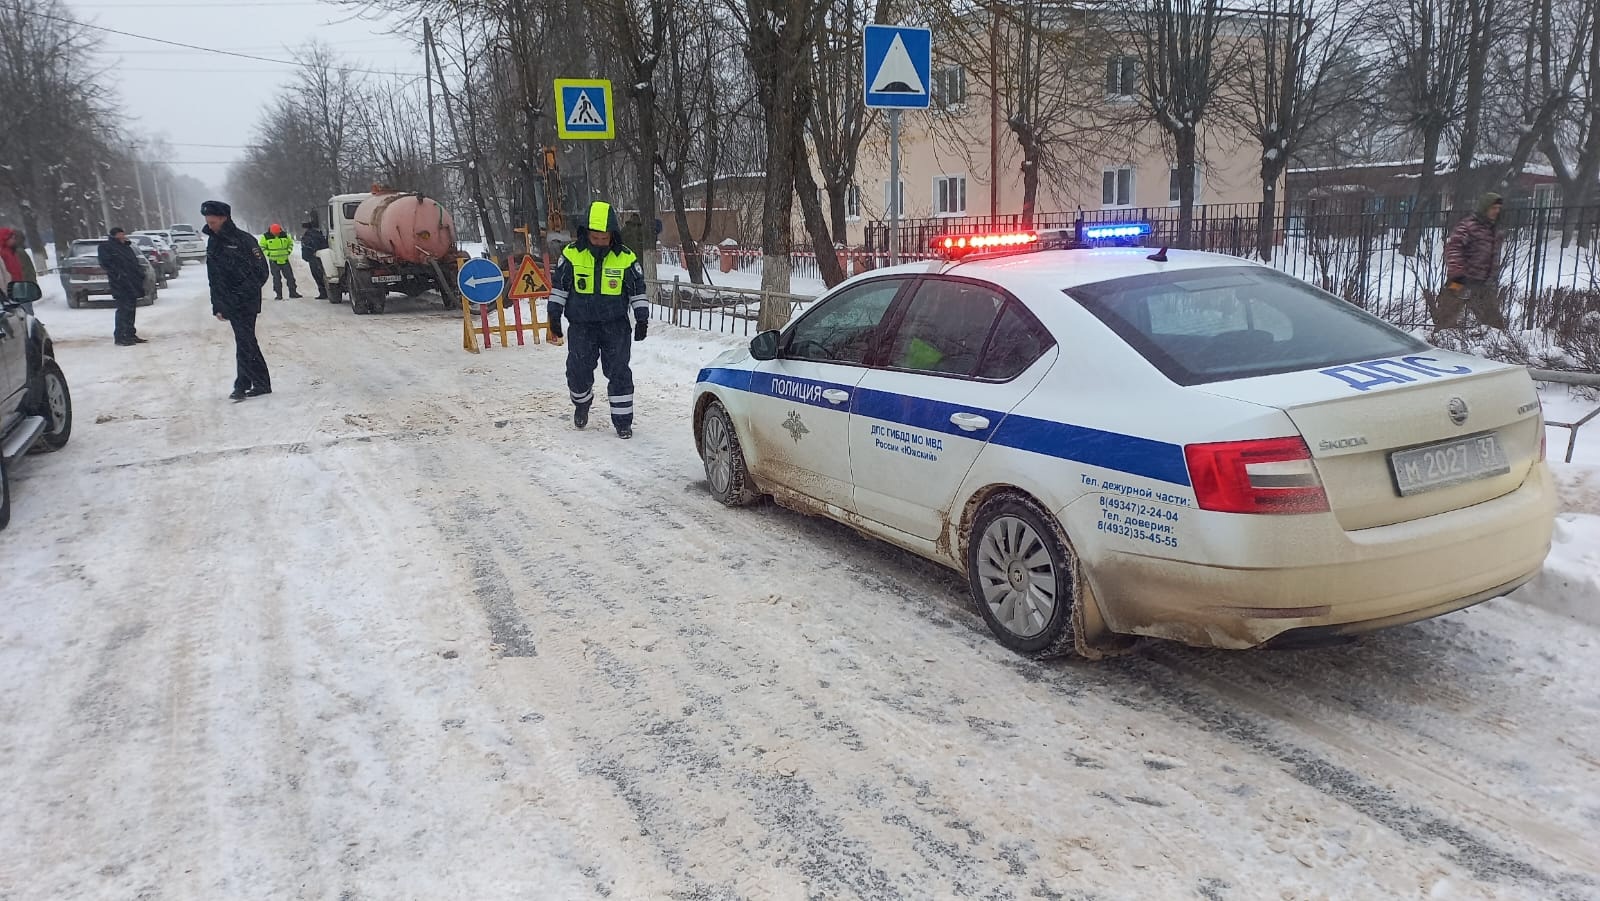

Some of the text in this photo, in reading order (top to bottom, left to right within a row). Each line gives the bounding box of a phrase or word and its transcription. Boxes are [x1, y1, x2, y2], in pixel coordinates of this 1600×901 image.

[1320, 356, 1473, 391] ДПС
[771, 378, 822, 403] ПОЛИЦИЯ
[870, 424, 943, 452] ДПС ГИБДД МО МВД
[875, 439, 938, 461] России «Южский»
[1423, 444, 1469, 478] 2027
[1477, 437, 1496, 458] 37
[1081, 474, 1190, 506] Тел. дежурной части:
[1099, 496, 1179, 522] 8(49347)2-24-04
[1102, 508, 1174, 534] Тел. доверия:
[1098, 521, 1177, 547] 8(4932)35-45-55
